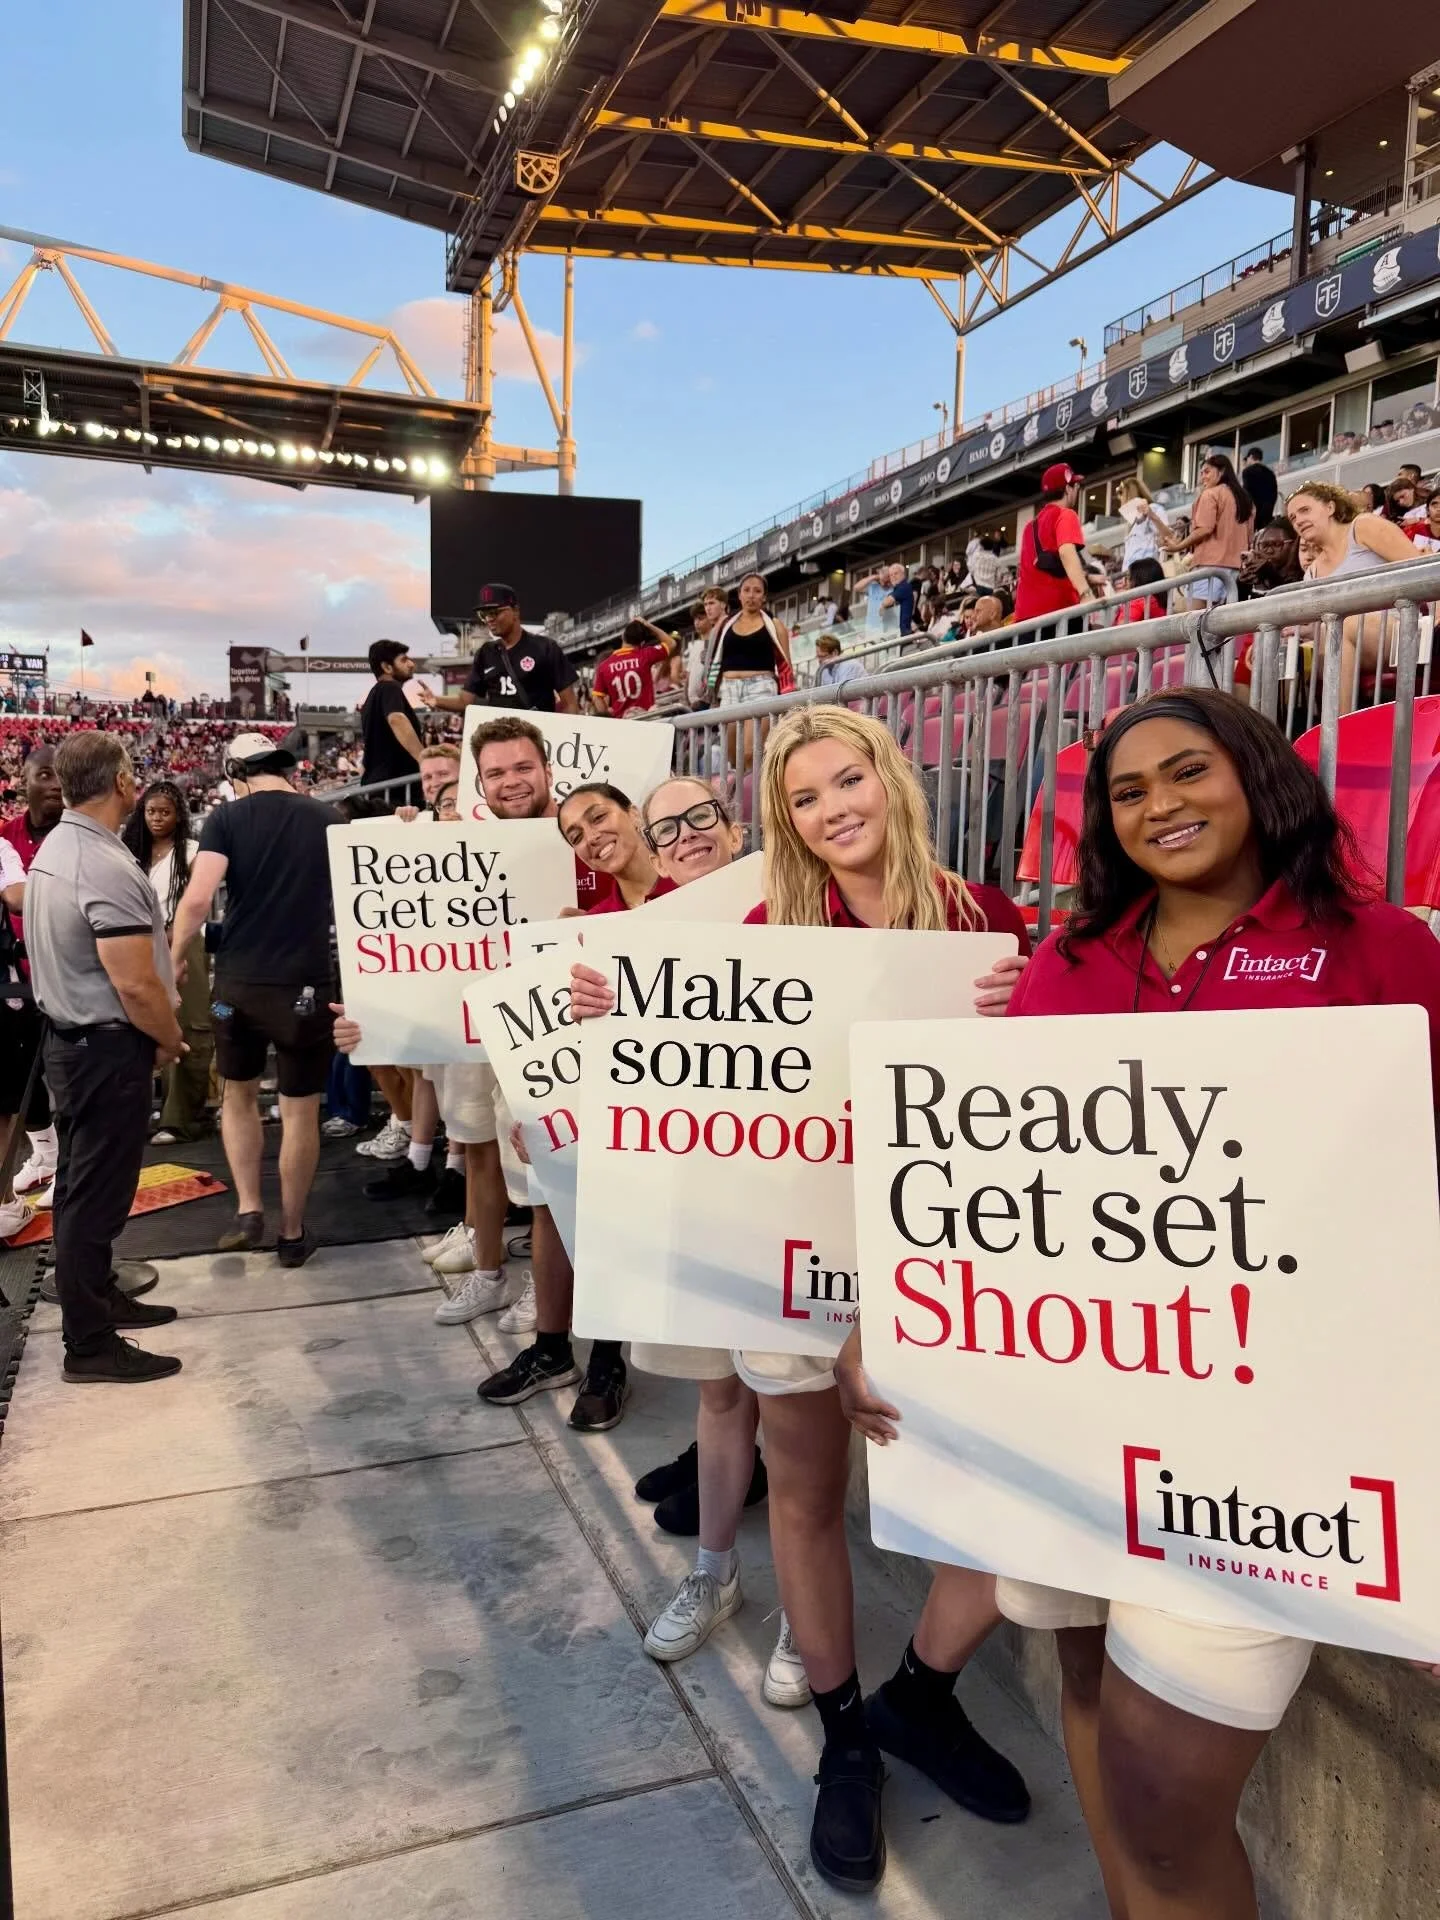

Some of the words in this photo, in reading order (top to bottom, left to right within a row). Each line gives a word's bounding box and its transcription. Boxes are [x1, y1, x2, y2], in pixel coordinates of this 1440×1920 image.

[969, 447, 989, 464] BMO
[500, 676, 517, 696] 15
[609, 657, 640, 673] TOTTI
[611, 670, 642, 702] 10
[348, 841, 506, 892] Ready.
[353, 889, 436, 929] Get
[447, 888, 528, 927] set.
[357, 931, 512, 974] Shout!
[1245, 971, 1293, 980] INSURANCE
[611, 955, 814, 1025] Make
[493, 984, 572, 1050] Ma
[522, 1041, 581, 1098] so
[610, 1038, 812, 1093] some
[606, 1100, 854, 1164] nooooi
[885, 1059, 1242, 1184] Ready.
[890, 1159, 1065, 1258] Get
[1091, 1176, 1298, 1274] set.
[894, 1257, 1255, 1385] Shout!
[1189, 1552, 1329, 1590] INSURANCE
